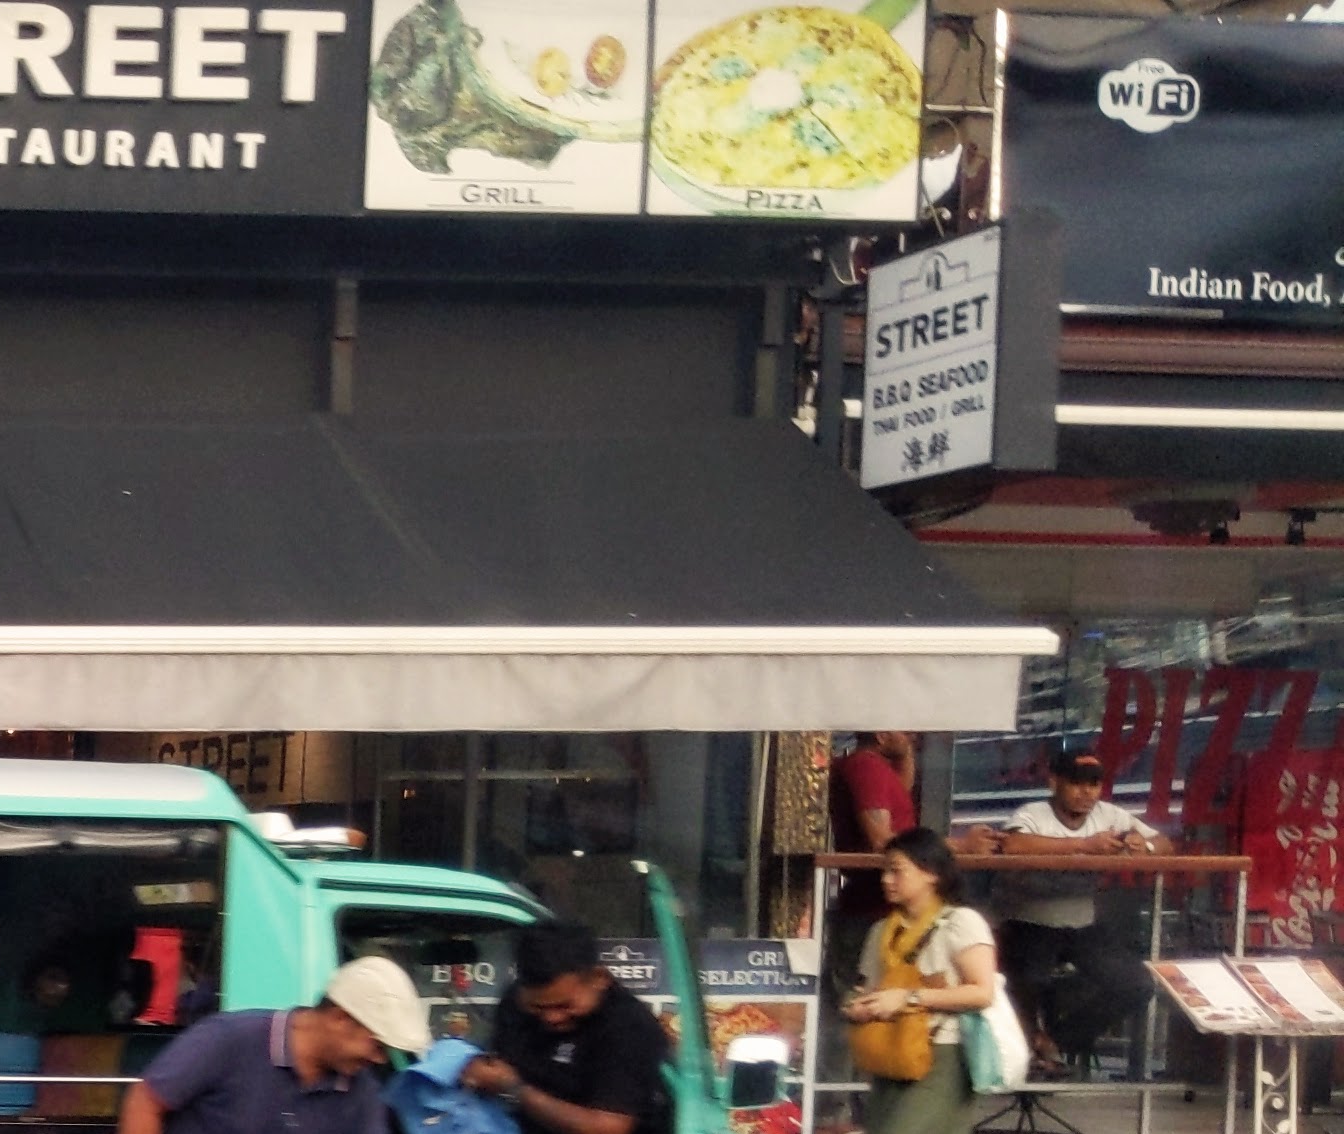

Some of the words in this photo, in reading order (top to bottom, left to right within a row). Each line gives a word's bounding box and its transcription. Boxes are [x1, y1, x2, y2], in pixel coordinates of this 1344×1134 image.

[1147, 266, 1243, 301] Indian
[1250, 271, 1331, 308] Food,
[875, 292, 990, 359] STREET
[917, 358, 990, 399] SEAFOOD
[1096, 664, 1344, 828] PIZZ
[748, 950, 786, 967] GRI
